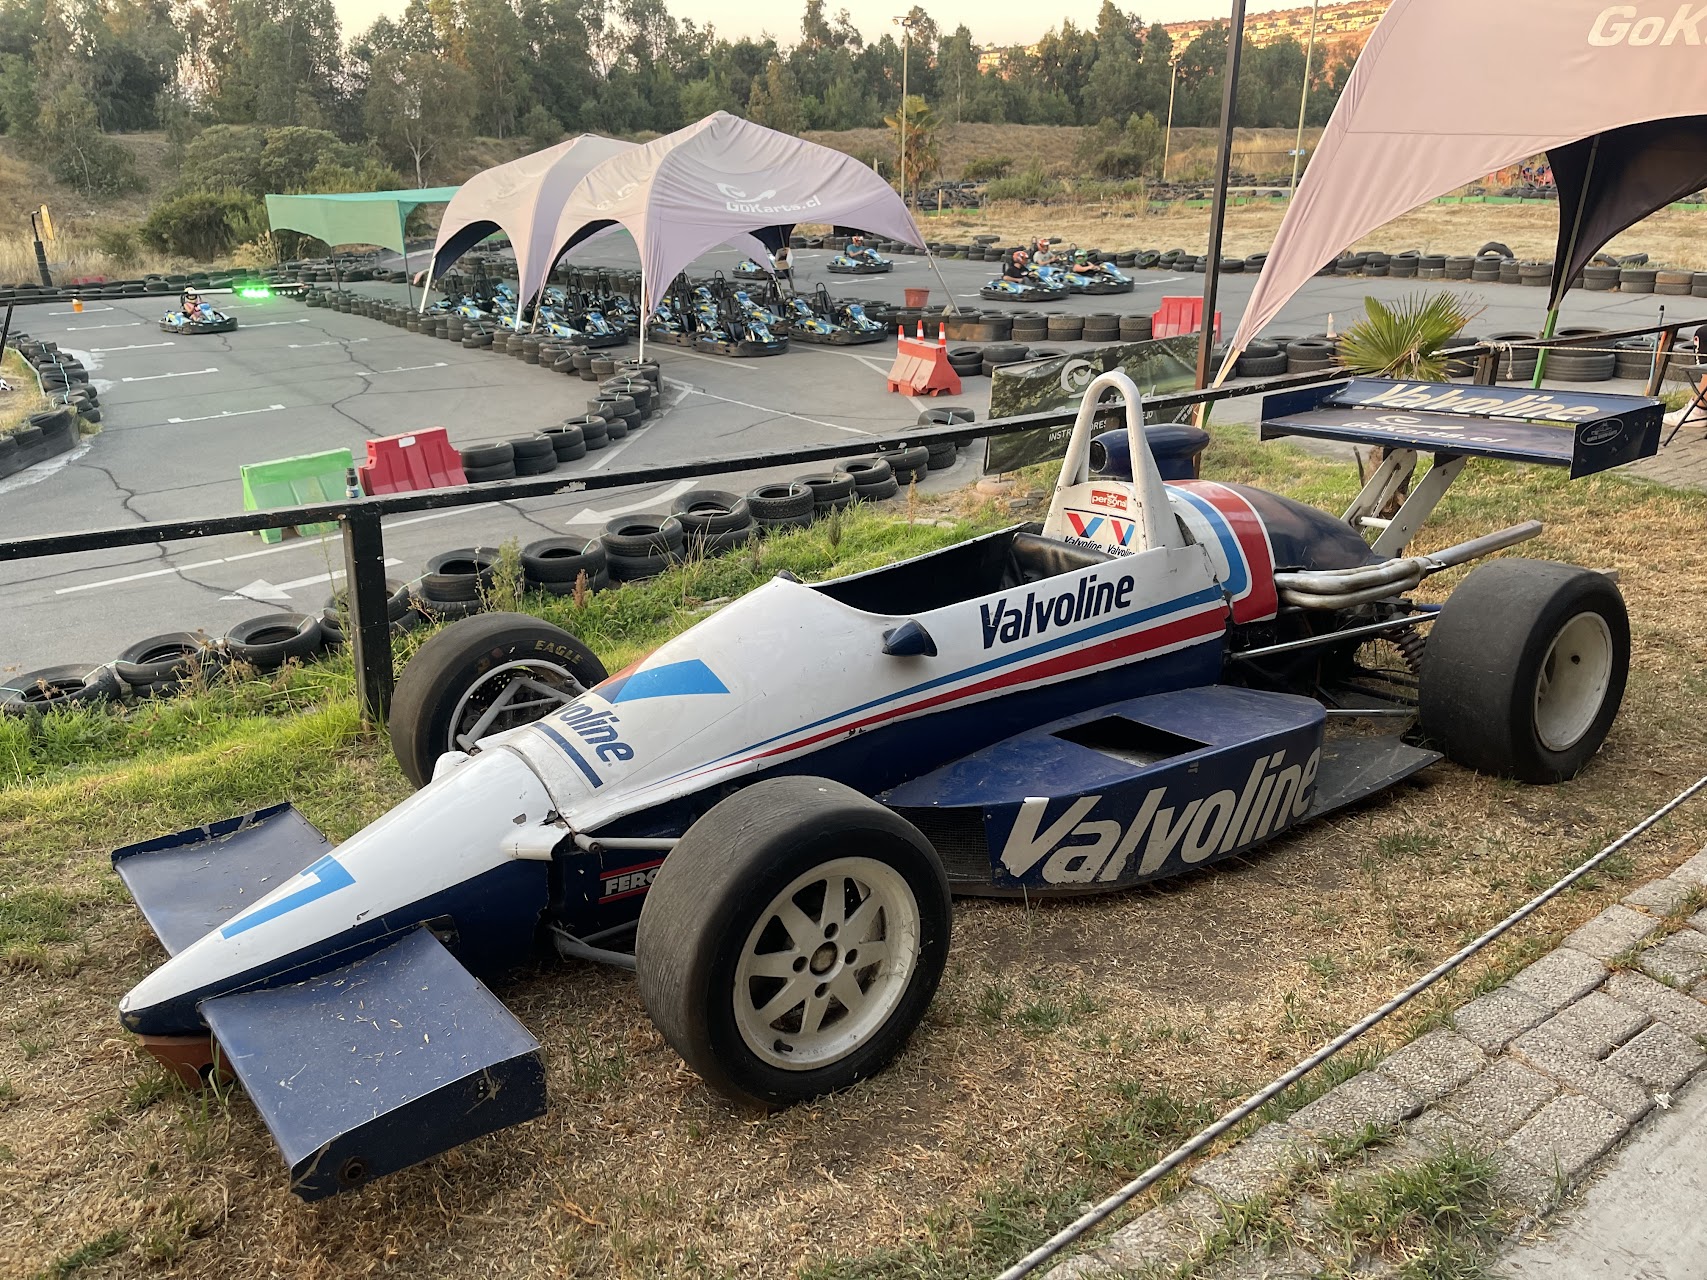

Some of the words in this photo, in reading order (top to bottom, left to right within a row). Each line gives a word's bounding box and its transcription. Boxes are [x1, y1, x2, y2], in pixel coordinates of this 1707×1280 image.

[1587, 3, 1707, 46] GoK
[726, 194, 822, 213] GoKarts.cl
[1360, 383, 1600, 421] Valvoline
[1341, 421, 1509, 443] GoKarts.cl
[1064, 535, 1103, 552] Valvoline
[1107, 543, 1136, 558] Valvolin
[979, 573, 1135, 650] Valvoline
[533, 639, 584, 665] EAGLE
[1000, 746, 1321, 885] Valvoline
